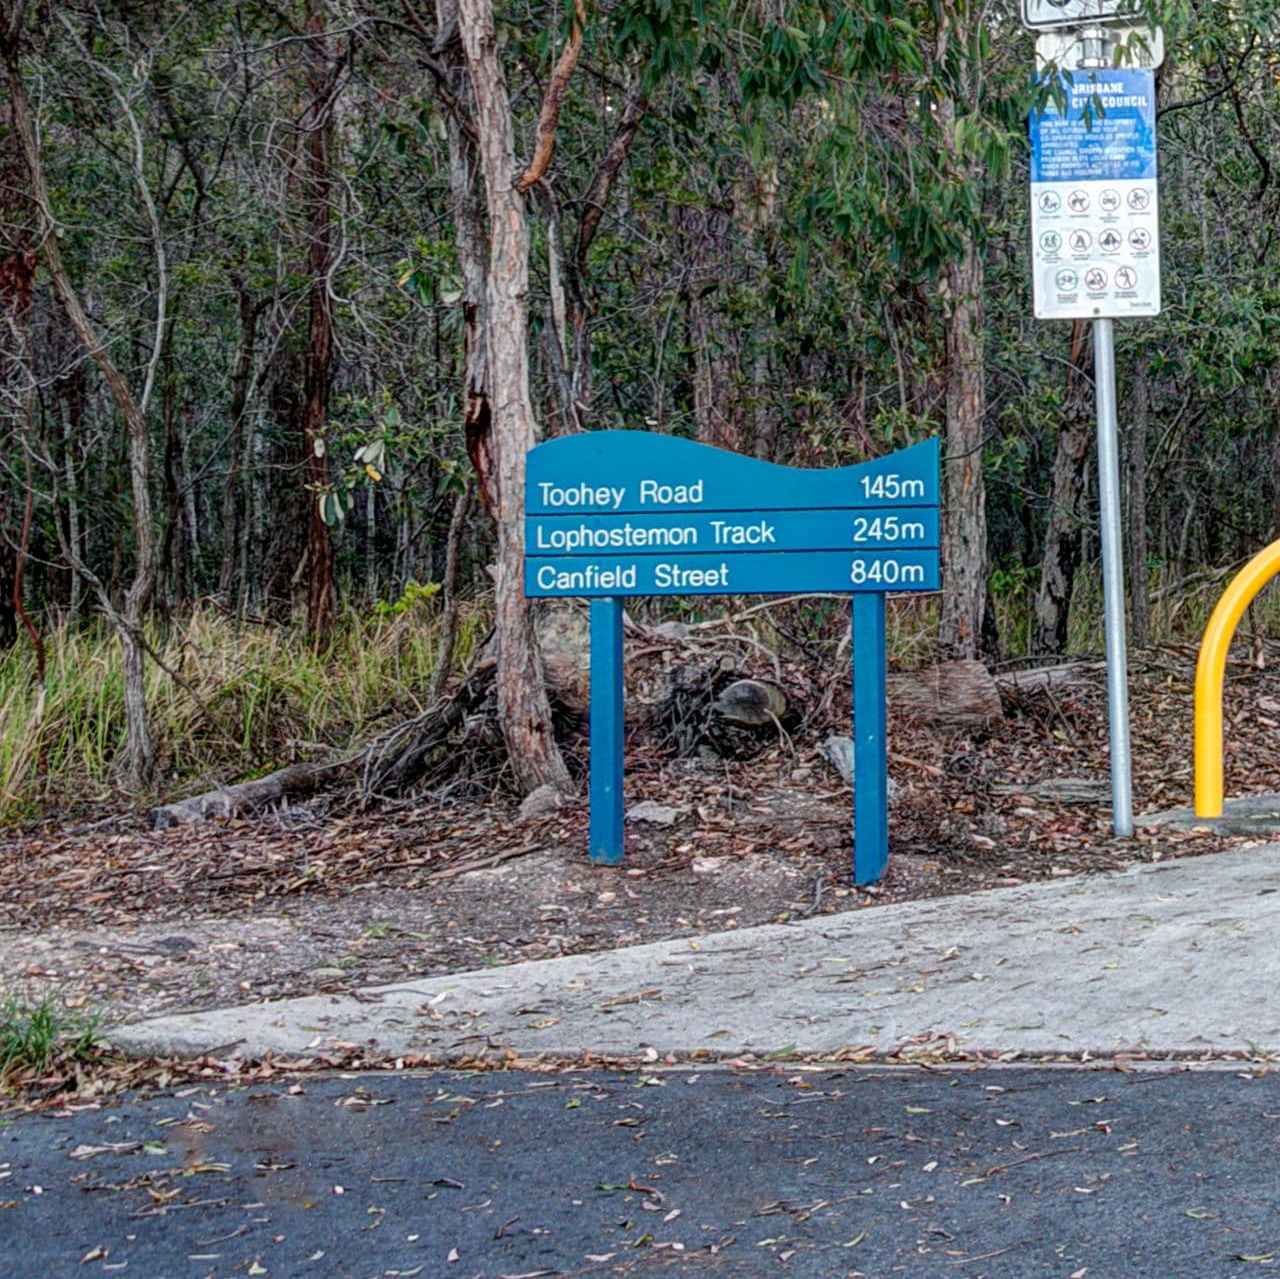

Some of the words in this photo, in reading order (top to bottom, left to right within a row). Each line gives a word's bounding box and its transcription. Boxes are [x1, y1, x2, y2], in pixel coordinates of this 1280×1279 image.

[1071, 95, 1093, 109] CIT
[1102, 95, 1148, 108] COUNCIL
[538, 482, 625, 509] Toohey
[640, 480, 703, 504] Road
[861, 474, 924, 499] 145m
[537, 523, 697, 552] Lophostemon
[710, 521, 775, 544] Track
[853, 516, 924, 542] 245m
[537, 565, 636, 590] Canfield
[655, 563, 729, 588] Street
[850, 559, 924, 584] 840m
